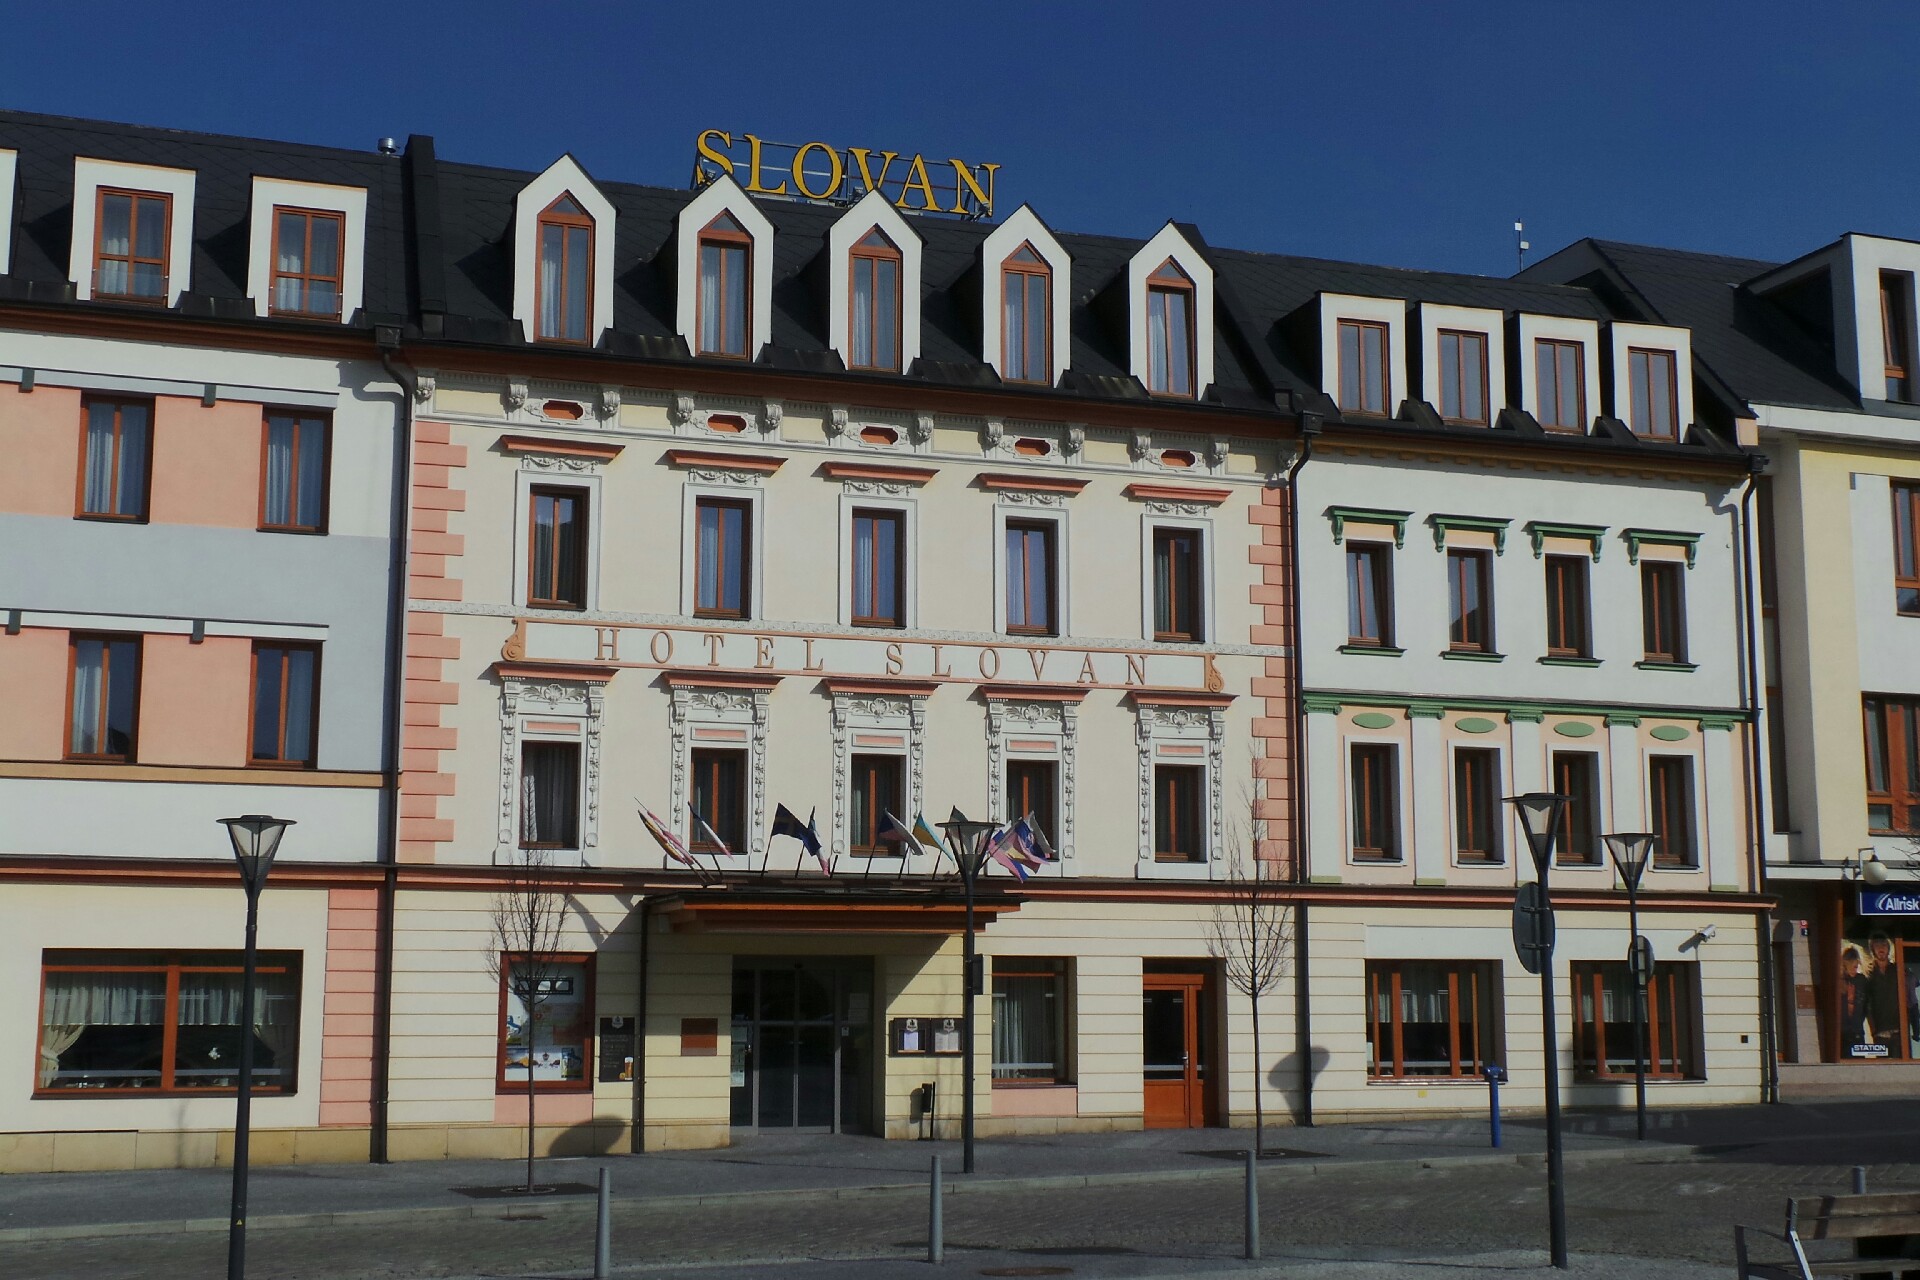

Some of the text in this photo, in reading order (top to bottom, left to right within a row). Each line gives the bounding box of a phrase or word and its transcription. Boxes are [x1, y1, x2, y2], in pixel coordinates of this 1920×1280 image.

[697, 129, 1001, 217] SLOVAN
[595, 628, 1149, 686] HOTEL SLOVAN
